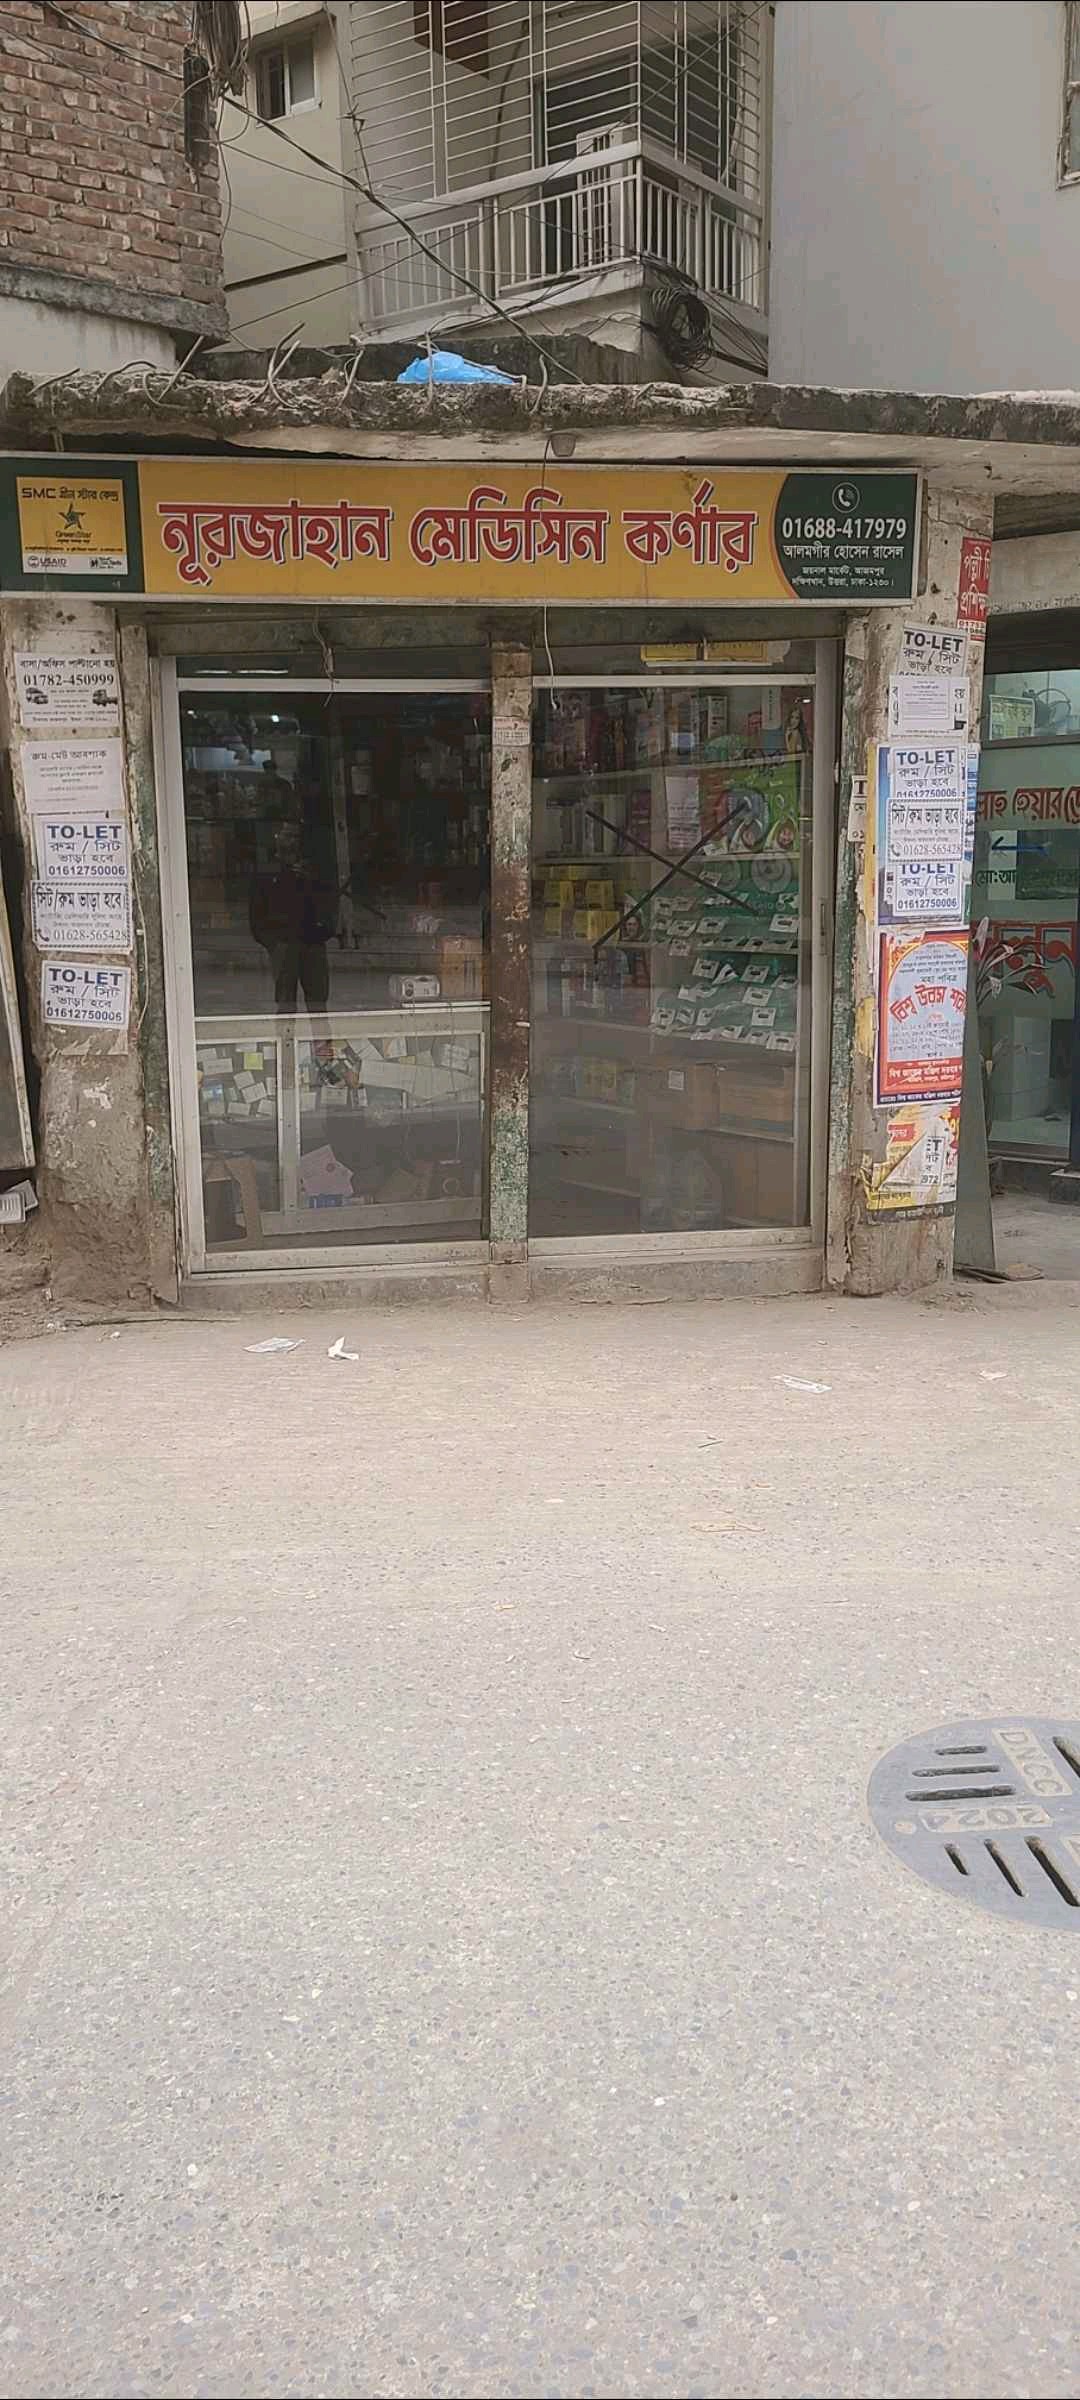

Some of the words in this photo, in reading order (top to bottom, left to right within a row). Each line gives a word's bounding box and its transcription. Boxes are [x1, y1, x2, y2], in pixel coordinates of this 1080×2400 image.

[21, 487, 57, 499] SMC
[157, 500, 394, 586] নূরজাহান
[409, 485, 610, 565] মেডিসিন
[621, 479, 757, 573] কর্ণার
[782, 518, 907, 540] 01688-417979
[783, 540, 830, 560] আলমগীর
[834, 545, 870, 560] হোসেন
[872, 546, 905, 560] রাসেল
[903, 630, 963, 652] TO-LET
[940, 650, 961, 664] সিট
[23, 674, 114, 686] 01782-450999
[896, 750, 955, 765] TO-LET
[934, 764, 955, 775] সিট
[1012, 787, 1065, 820] হেয়ার
[47, 825, 122, 839] TO-LET
[95, 840, 121, 851] সিট
[48, 865, 126, 876] 01612750006
[901, 863, 954, 874] TO-LET
[48, 968, 123, 985] TO-LET
